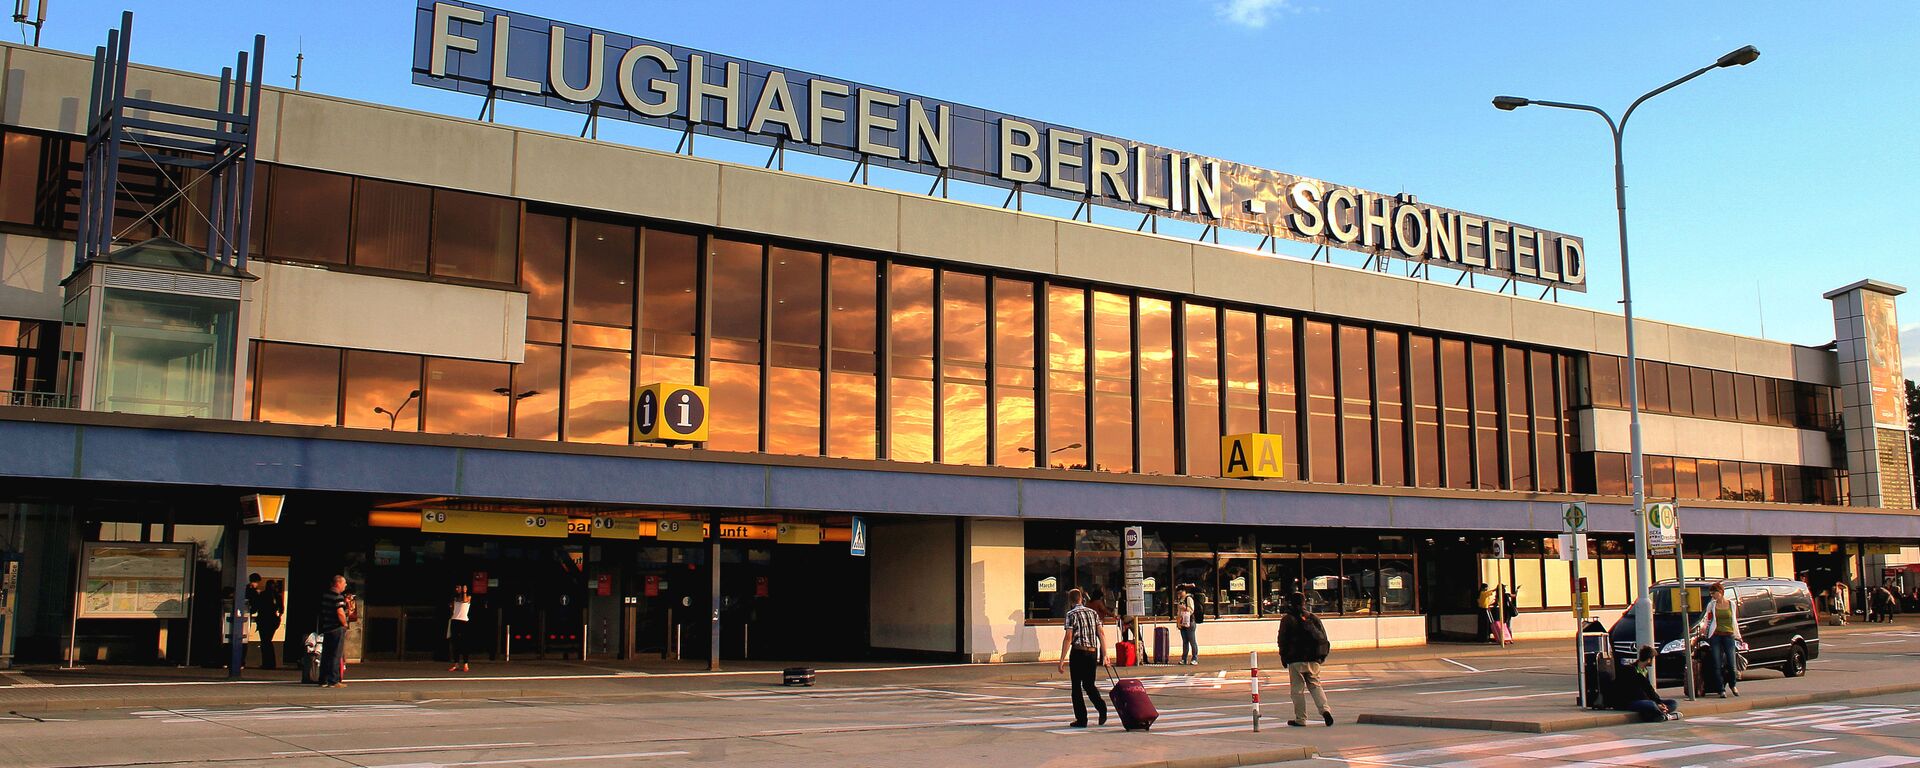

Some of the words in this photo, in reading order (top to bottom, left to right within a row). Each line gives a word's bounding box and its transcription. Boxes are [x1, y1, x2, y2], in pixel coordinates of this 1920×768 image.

[429, 1, 950, 169] FLUGHAFEN
[998, 116, 1222, 219] BERLIN
[1288, 181, 1586, 285] SCHÖNEFELD
[1227, 439, 1249, 474] A
[1258, 438, 1279, 473] A
[1126, 535, 1137, 543] BUS
[10, 564, 18, 590] Service
